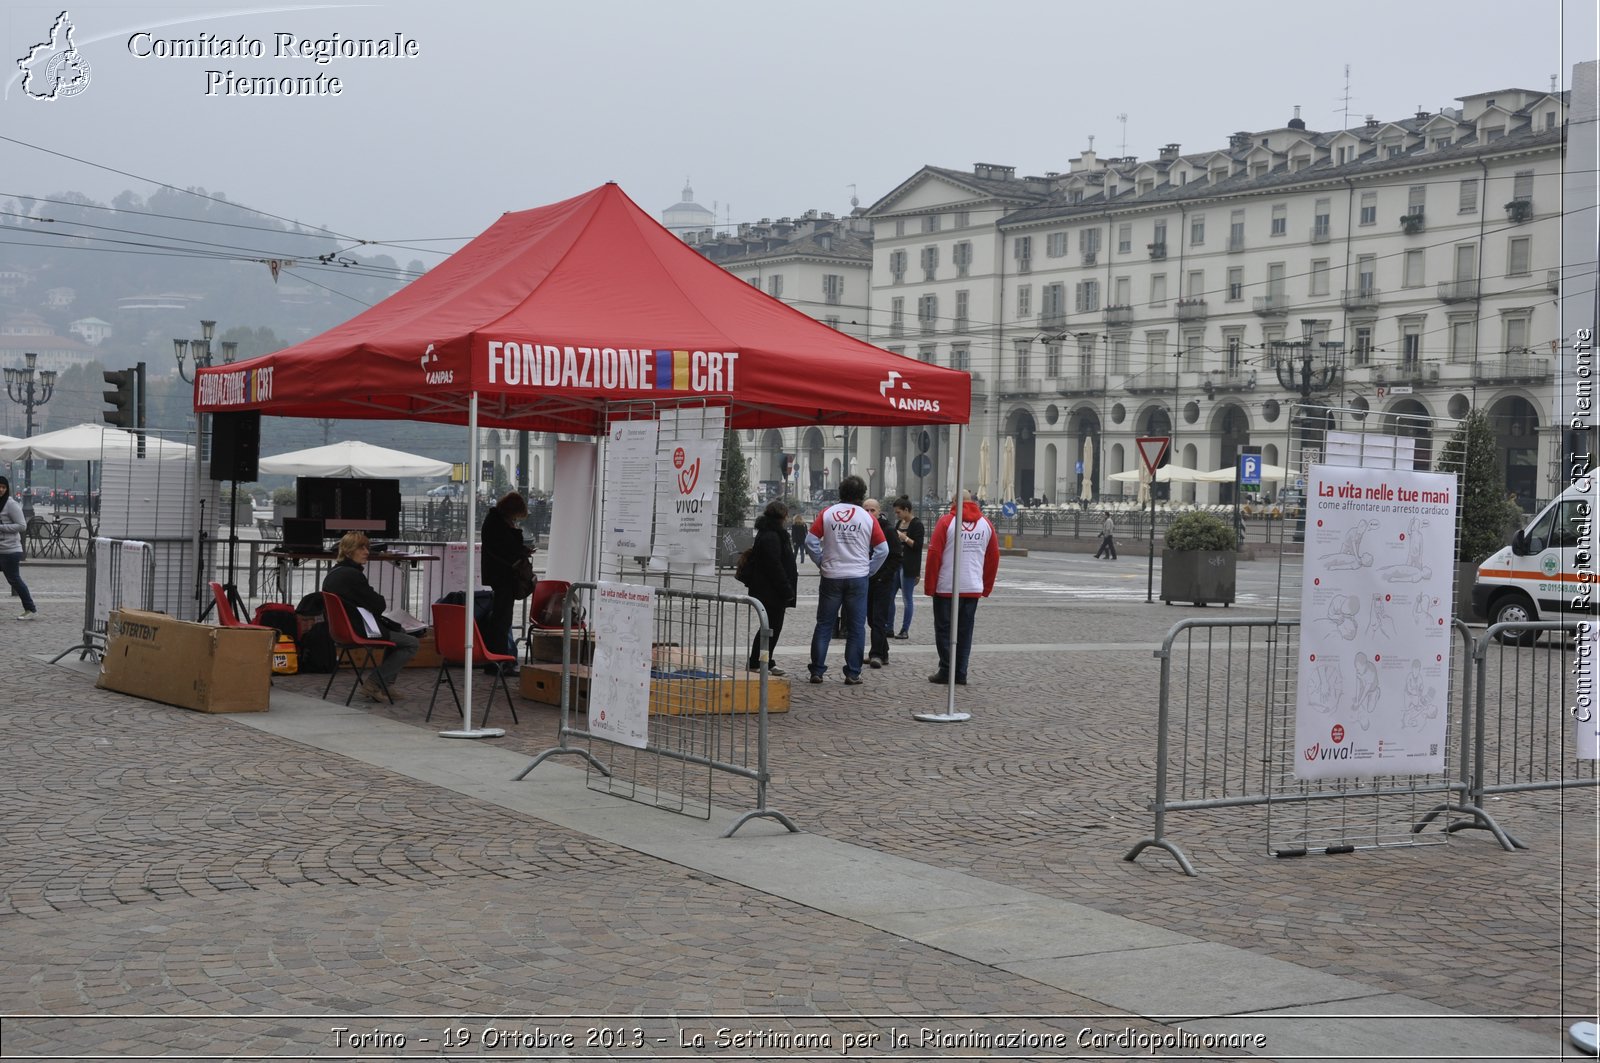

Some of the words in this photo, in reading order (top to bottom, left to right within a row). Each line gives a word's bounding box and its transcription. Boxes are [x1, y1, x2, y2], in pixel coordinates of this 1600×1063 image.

[488, 341, 652, 390] FONDAZIONE
[691, 351, 739, 392] CRT
[429, 370, 454, 384] ANPAS
[198, 371, 245, 406] FONDAZIONE
[257, 366, 274, 402] CRT
[898, 397, 940, 412] ANPAS
[1245, 461, 1256, 477] P
[1318, 481, 1334, 497] La
[1338, 482, 1362, 499] vita
[1366, 483, 1393, 501] nelle
[1398, 487, 1418, 502] tue
[1421, 488, 1449, 504] mani
[676, 492, 705, 514] viva!
[1318, 501, 1340, 510] come
[1341, 501, 1380, 512] affrontare
[1381, 504, 1391, 512] un
[1392, 504, 1420, 514] arresto
[1421, 505, 1449, 516] cardiaco
[831, 522, 862, 533] viva!
[600, 588, 606, 597] La
[607, 588, 615, 598] vita
[616, 590, 627, 600] nelle
[628, 592, 636, 601] tue
[637, 592, 650, 602] mani
[1321, 742, 1353, 760] viva!
